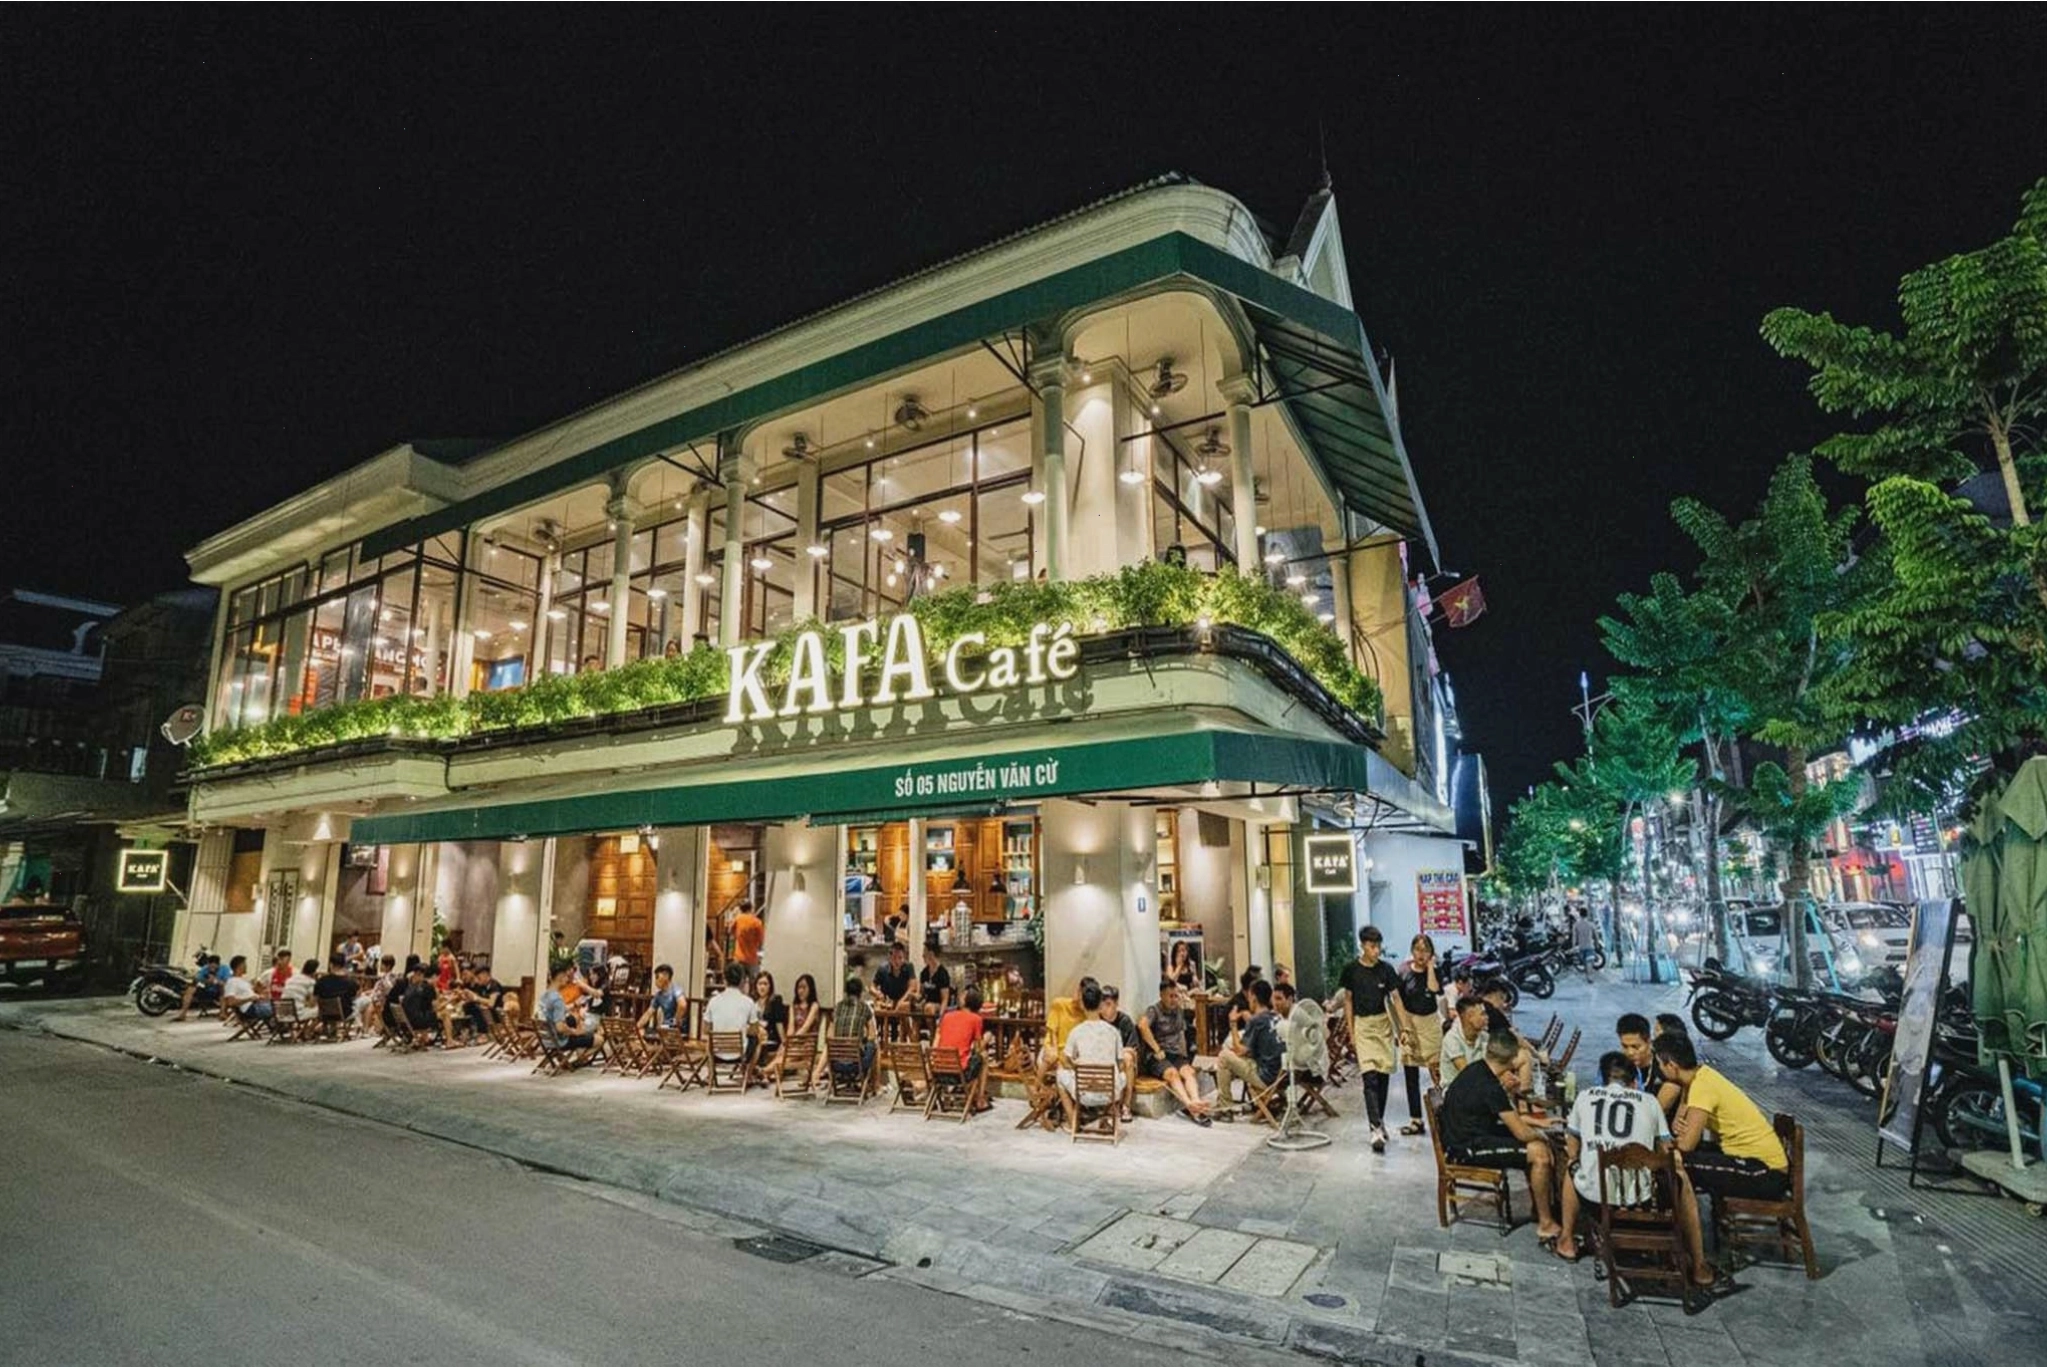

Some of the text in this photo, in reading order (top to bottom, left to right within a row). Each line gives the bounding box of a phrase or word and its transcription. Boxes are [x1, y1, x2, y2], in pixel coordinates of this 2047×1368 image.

[723, 614, 1078, 724] KAFA Café
[895, 757, 1059, 797] SỐ 05 NGUYỄN VĂN CỪ
[1590, 1098, 1635, 1138] 10
